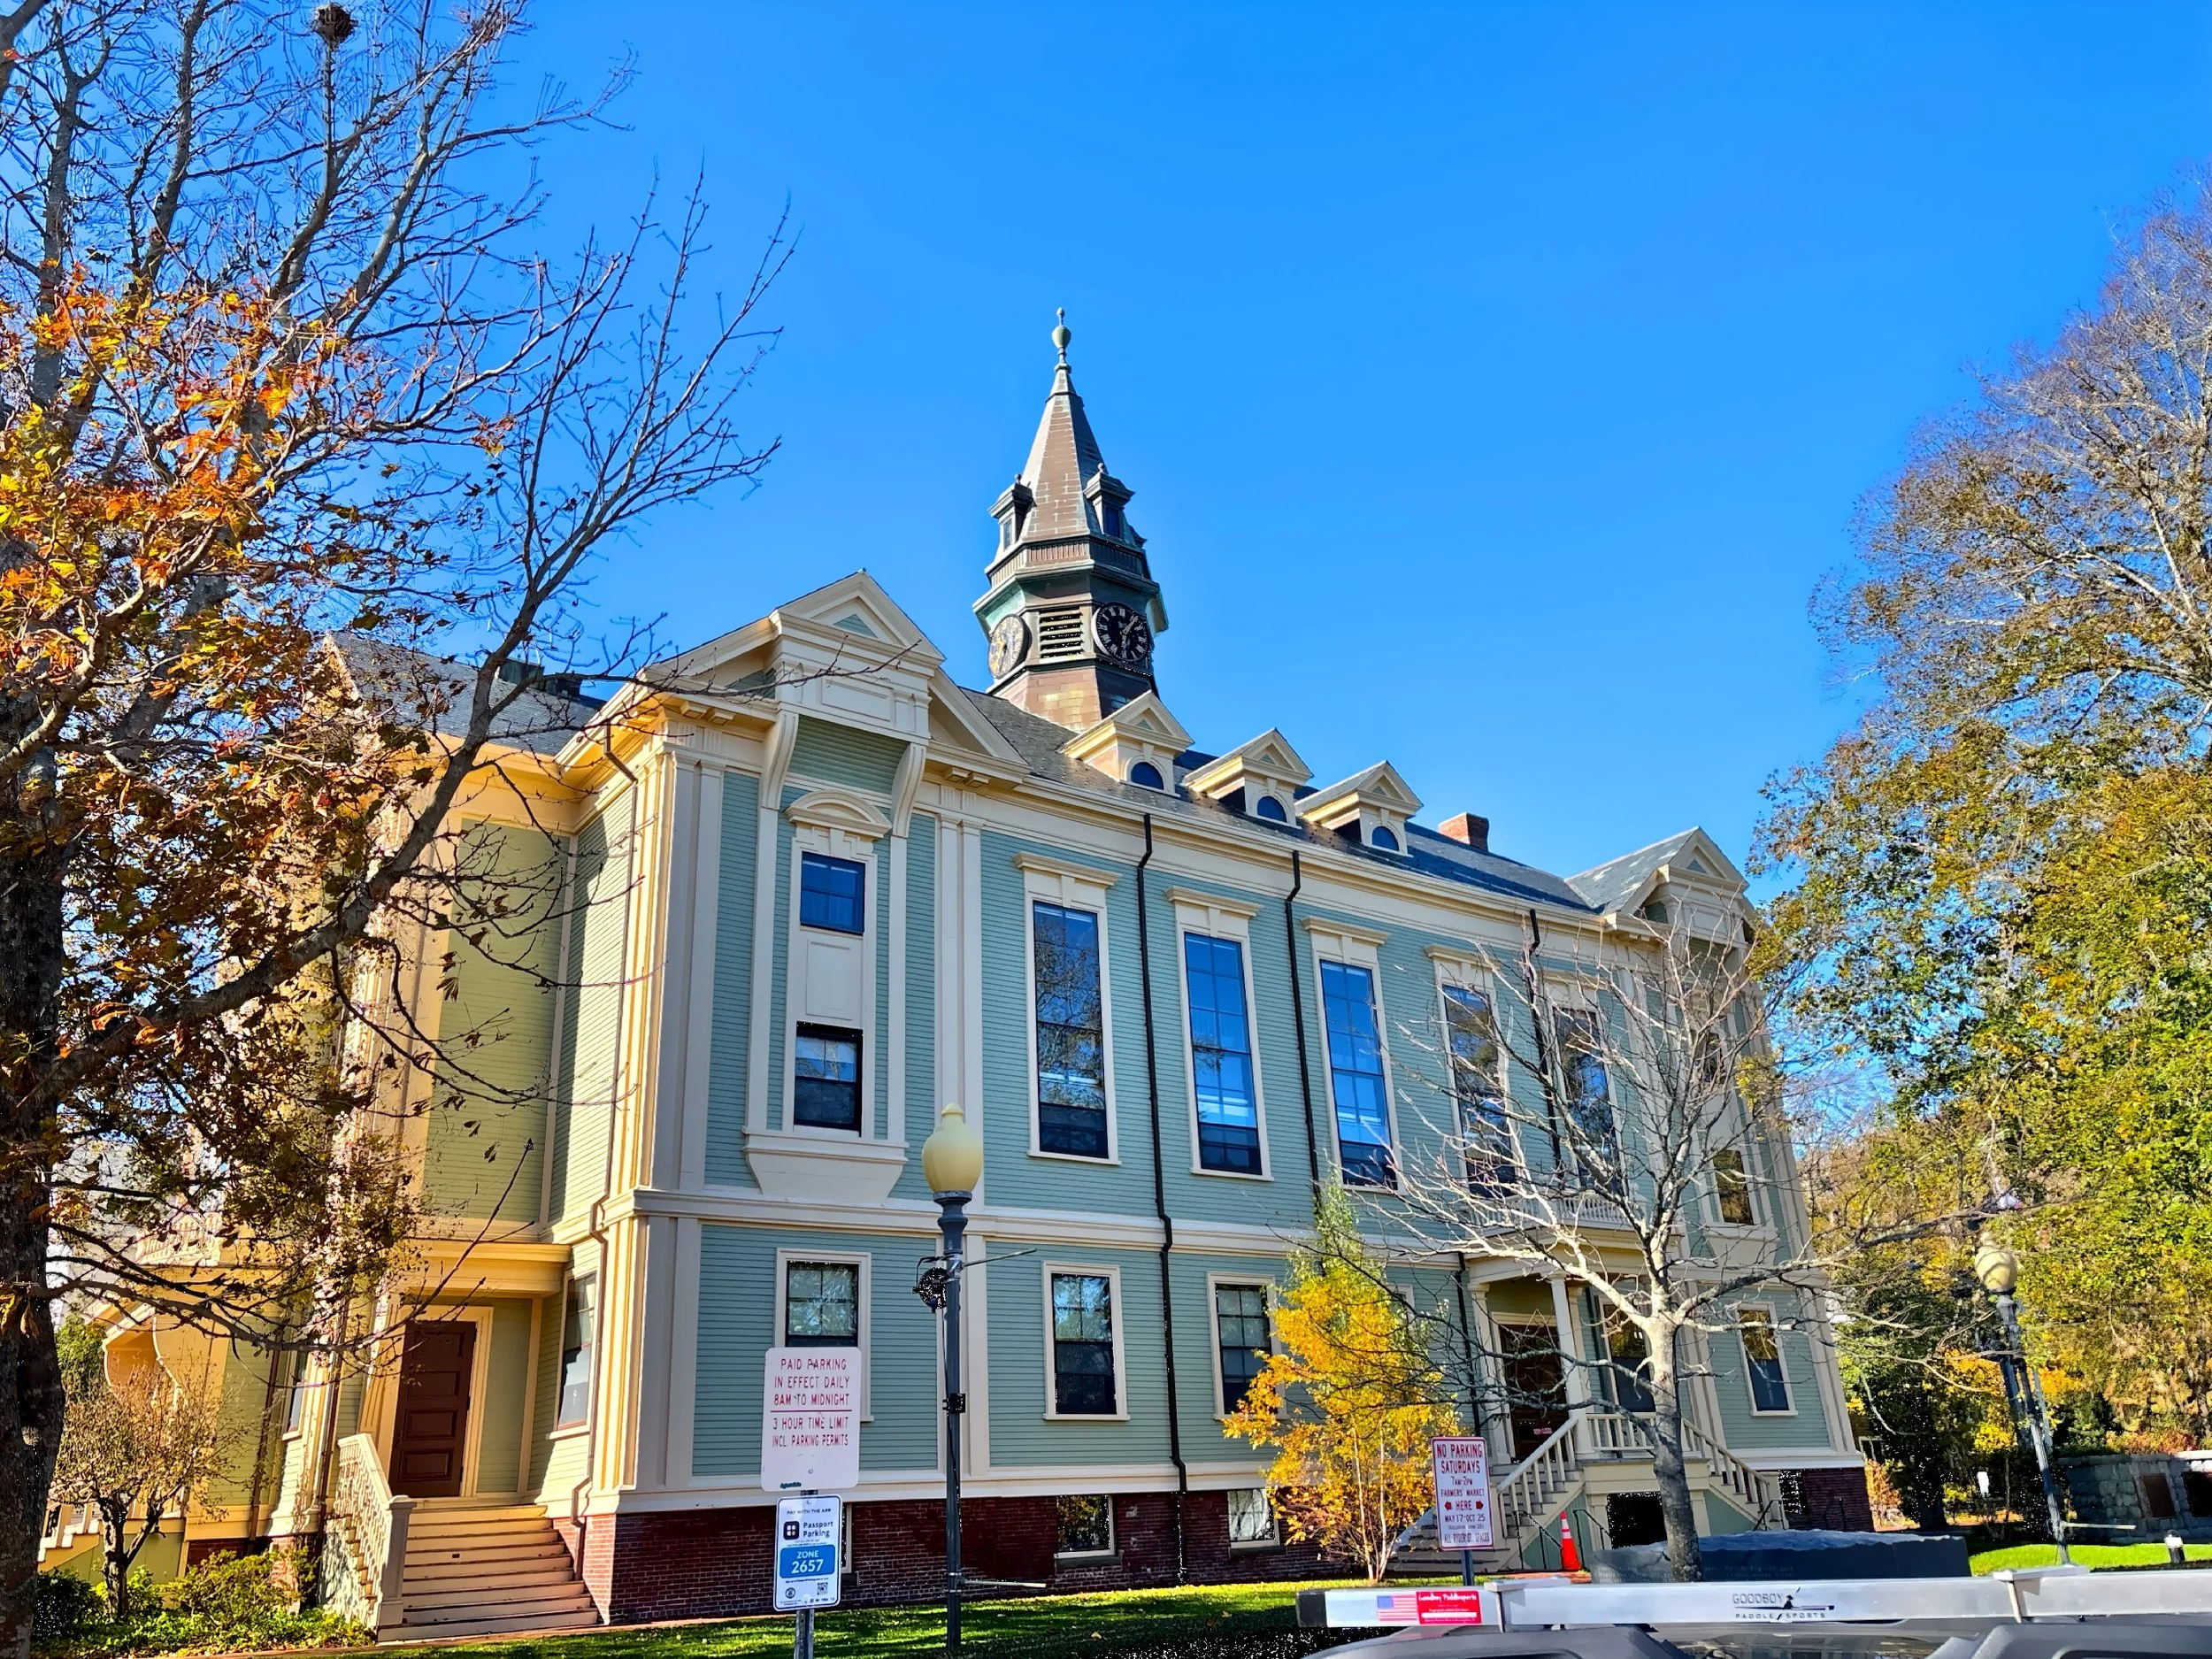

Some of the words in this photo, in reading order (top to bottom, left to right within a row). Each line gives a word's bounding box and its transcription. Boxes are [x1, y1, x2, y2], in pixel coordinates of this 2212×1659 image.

[780, 1358, 802, 1371] PAID
[807, 1358, 847, 1371] PARKING
[774, 1377, 783, 1388] IN
[787, 1376, 819, 1388] EFFECT
[824, 1376, 849, 1388] DAILY
[773, 1394, 792, 1406] 8AM
[796, 1394, 807, 1405] TO
[810, 1393, 849, 1405] MIDNIGHT
[772, 1417, 778, 1430] 3
[781, 1417, 803, 1430] HOUR
[808, 1417, 825, 1429] TIME
[829, 1417, 849, 1429] LIMIT
[772, 1435, 788, 1448] INCL.
[791, 1435, 819, 1447] PARKING
[822, 1433, 849, 1447] PERMITS
[1436, 1443, 1447, 1458] NO
[1450, 1443, 1483, 1458] PARKING
[1440, 1460, 1481, 1474] SATURDAYS
[1466, 1488, 1485, 1497] MARKET
[1455, 1500, 1473, 1511] HERE
[1444, 1514, 1455, 1523] MAY
[1478, 1513, 1486, 1522] 25
[803, 1521, 833, 1530] Passport
[803, 1529, 830, 1539] Parking
[796, 1550, 819, 1559] ZONE
[791, 1559, 824, 1574] 2657
[1732, 1593, 1783, 1604] GOODBOY
